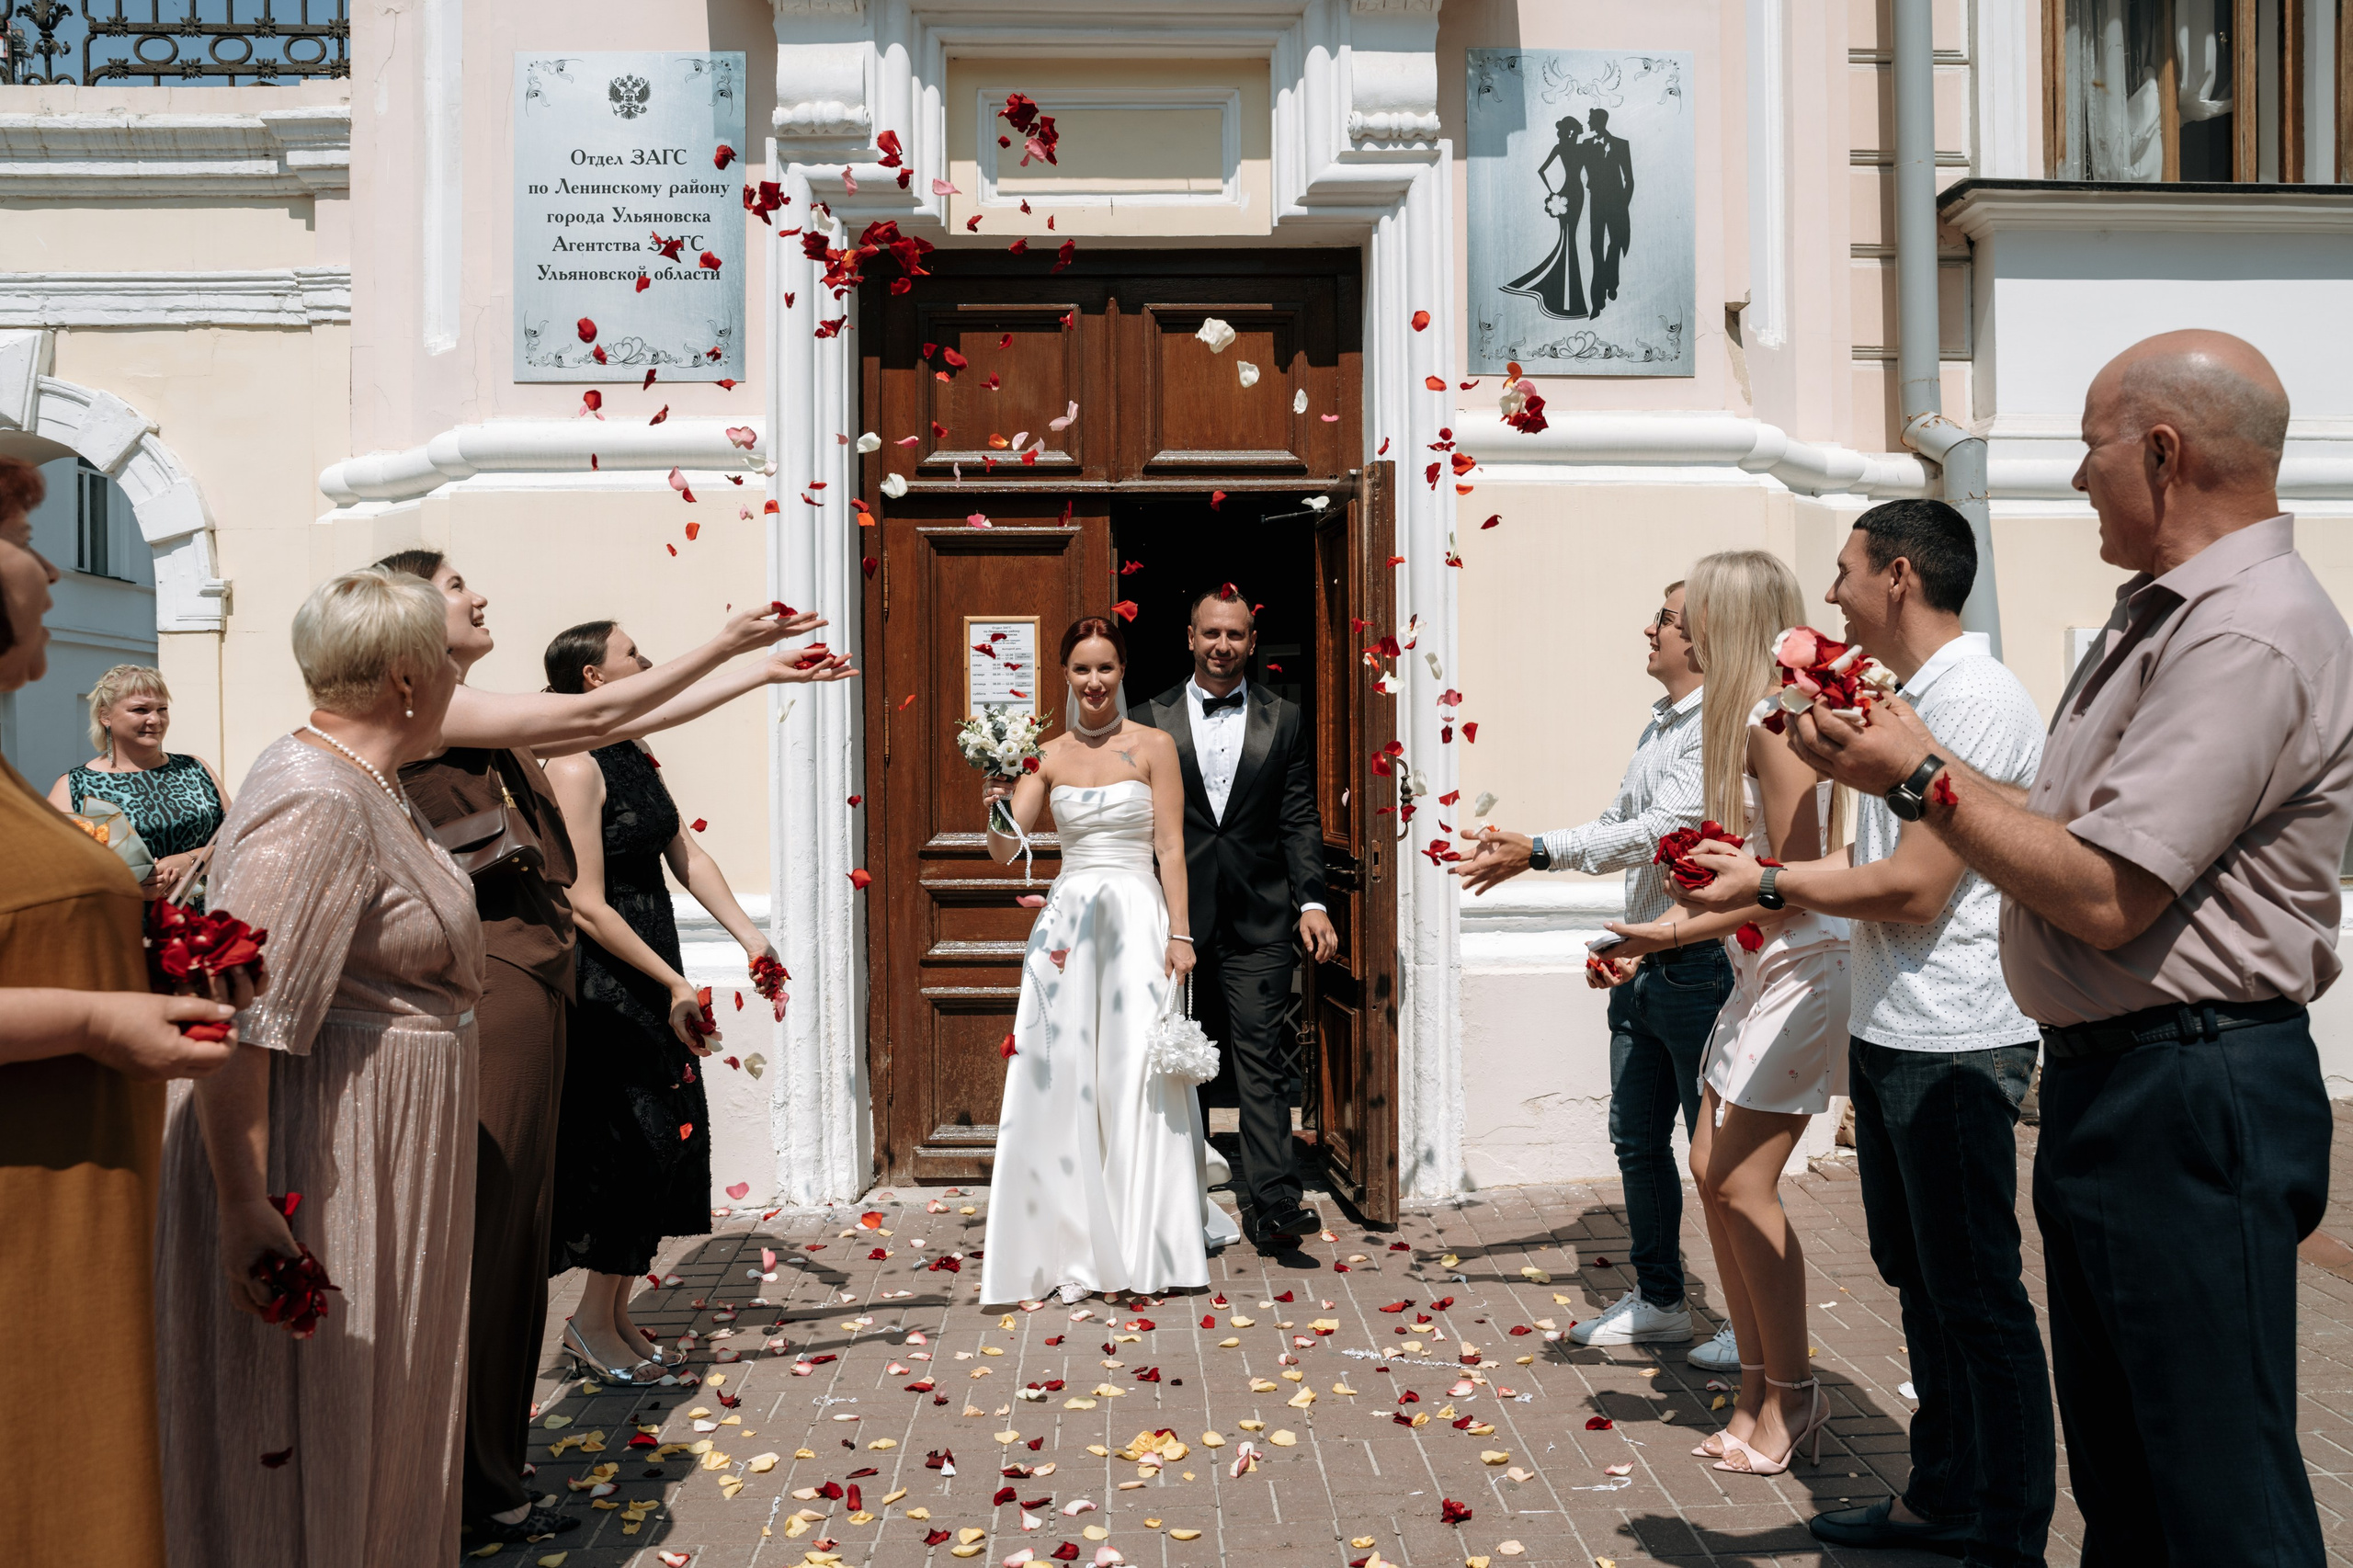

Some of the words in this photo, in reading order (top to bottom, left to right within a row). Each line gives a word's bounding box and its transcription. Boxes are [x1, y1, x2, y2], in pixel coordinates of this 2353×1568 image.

[570, 149, 624, 167] Отдел
[630, 148, 688, 166] ЗАГС
[529, 184, 549, 195] по
[554, 178, 663, 198] Ленинскому
[669, 178, 731, 198] району
[546, 210, 605, 227] города
[612, 207, 712, 224] Ульяновска
[551, 235, 642, 252] Агентства
[537, 264, 648, 281] Ульяновской
[654, 266, 722, 281] области
